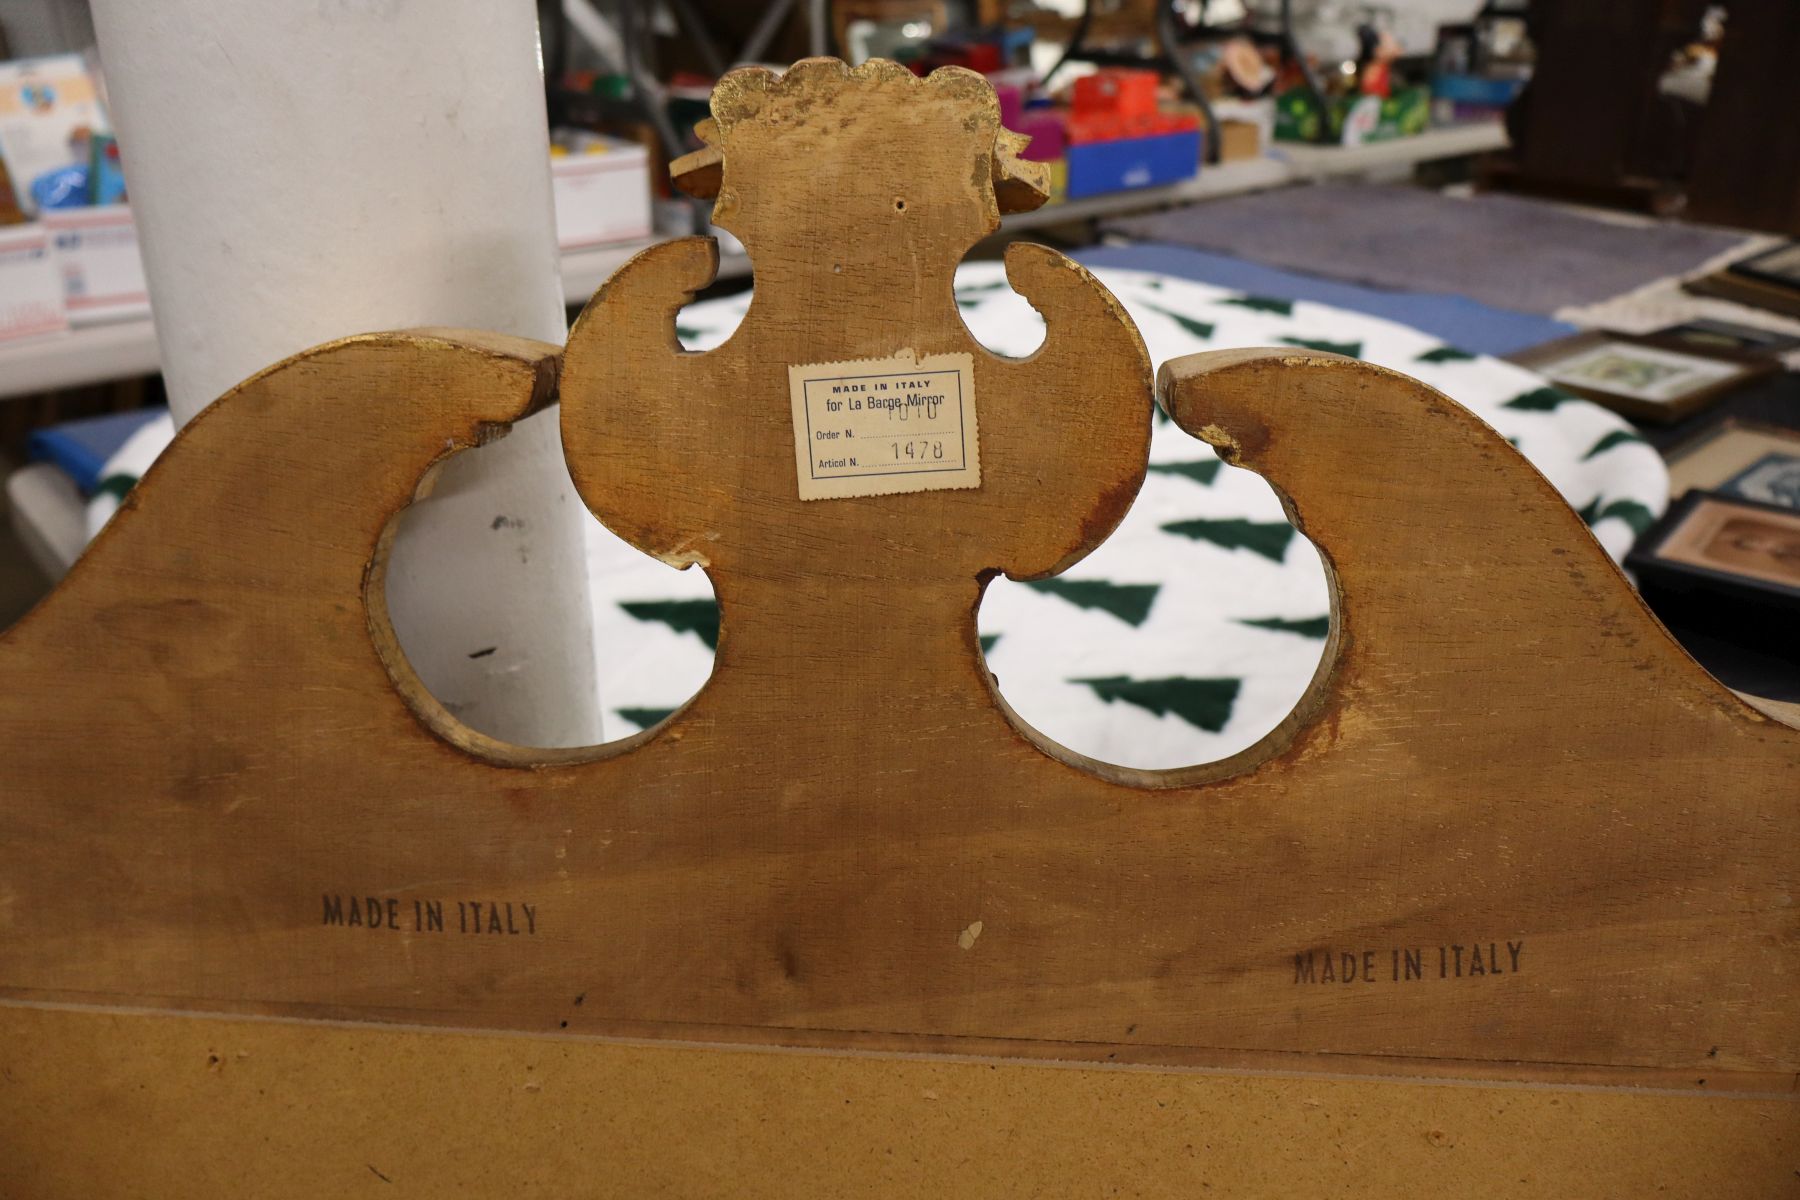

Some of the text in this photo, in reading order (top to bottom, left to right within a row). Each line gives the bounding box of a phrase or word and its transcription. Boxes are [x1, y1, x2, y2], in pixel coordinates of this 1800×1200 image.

[832, 385, 866, 393] MADE
[896, 380, 930, 389] ITALY
[826, 398, 843, 412] for
[848, 398, 862, 410] La
[906, 393, 945, 407] Mirror
[816, 429, 855, 440] Order N.
[818, 441, 943, 469] Articol N. 1478
[322, 894, 537, 935] MADE IN ITALY
[1293, 940, 1524, 985] MADE IN ITALY
